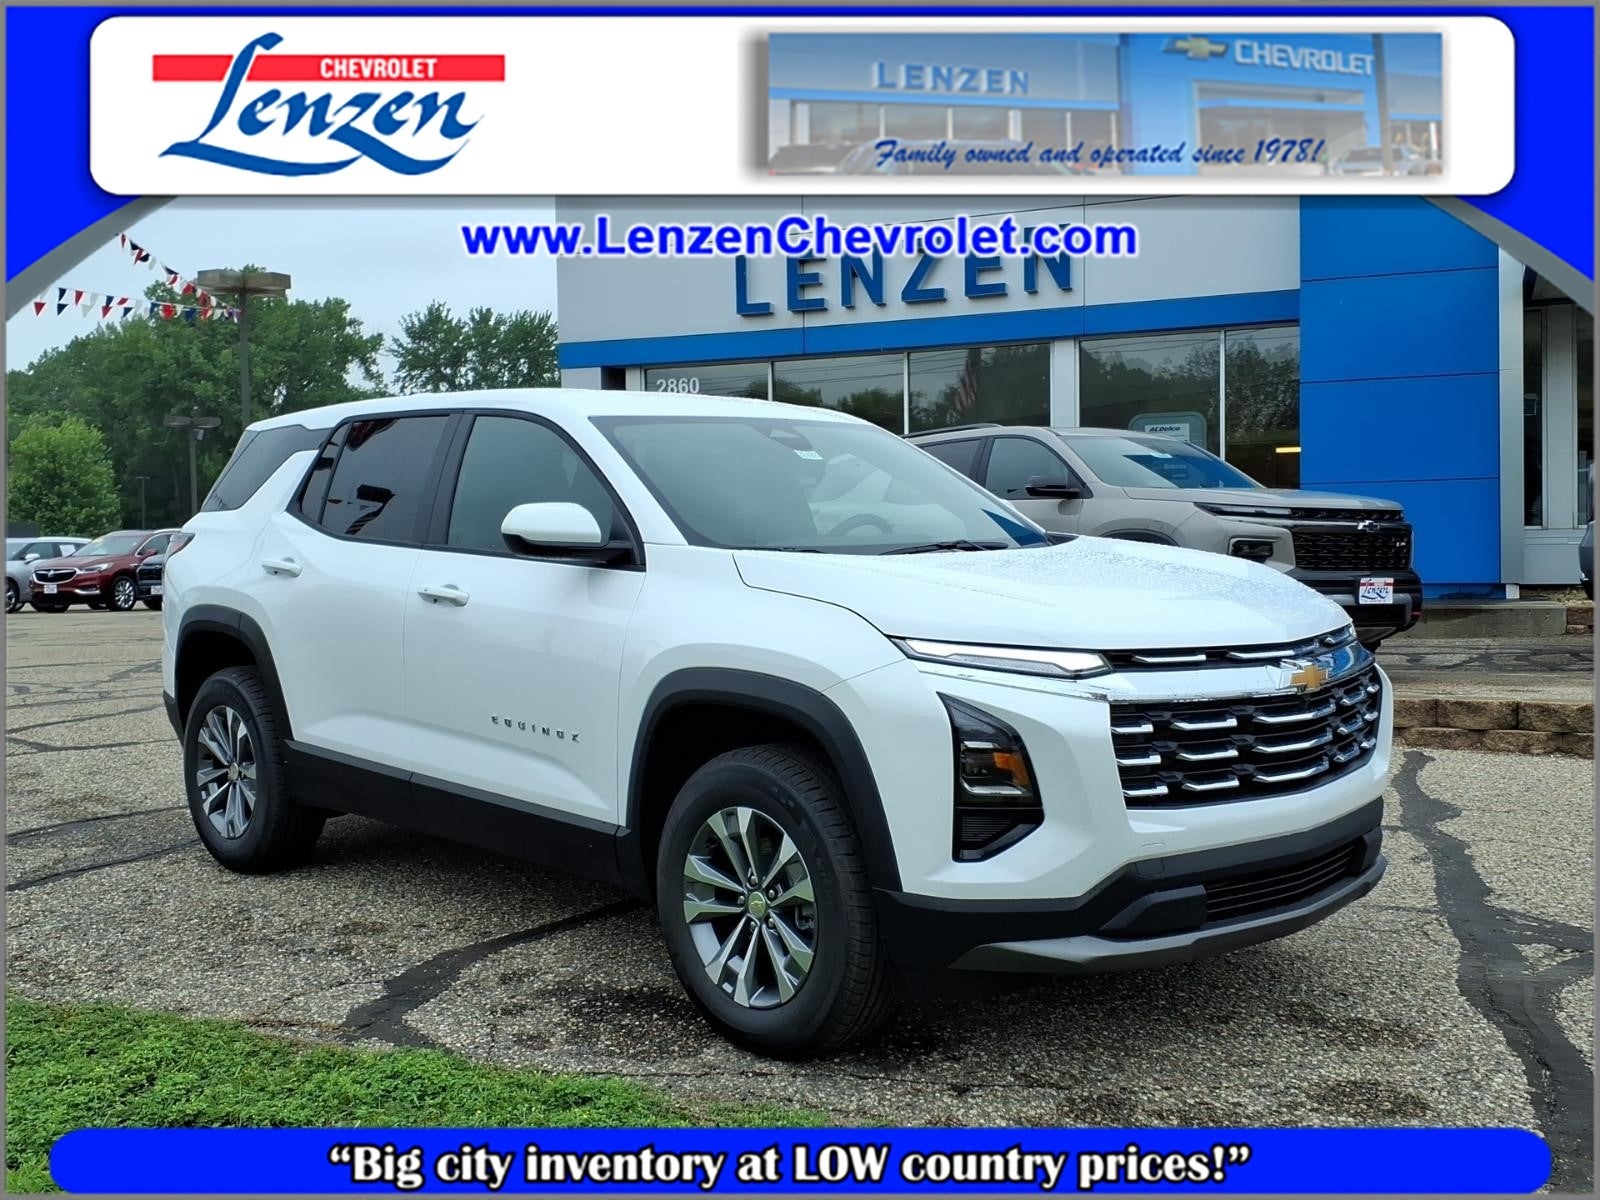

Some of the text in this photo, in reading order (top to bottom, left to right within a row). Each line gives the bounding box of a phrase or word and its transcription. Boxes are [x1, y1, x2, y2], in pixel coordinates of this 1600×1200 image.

[735, 223, 1074, 317] LENZEN
[656, 377, 700, 394] 2860
[491, 716, 580, 743] EQUINOX
